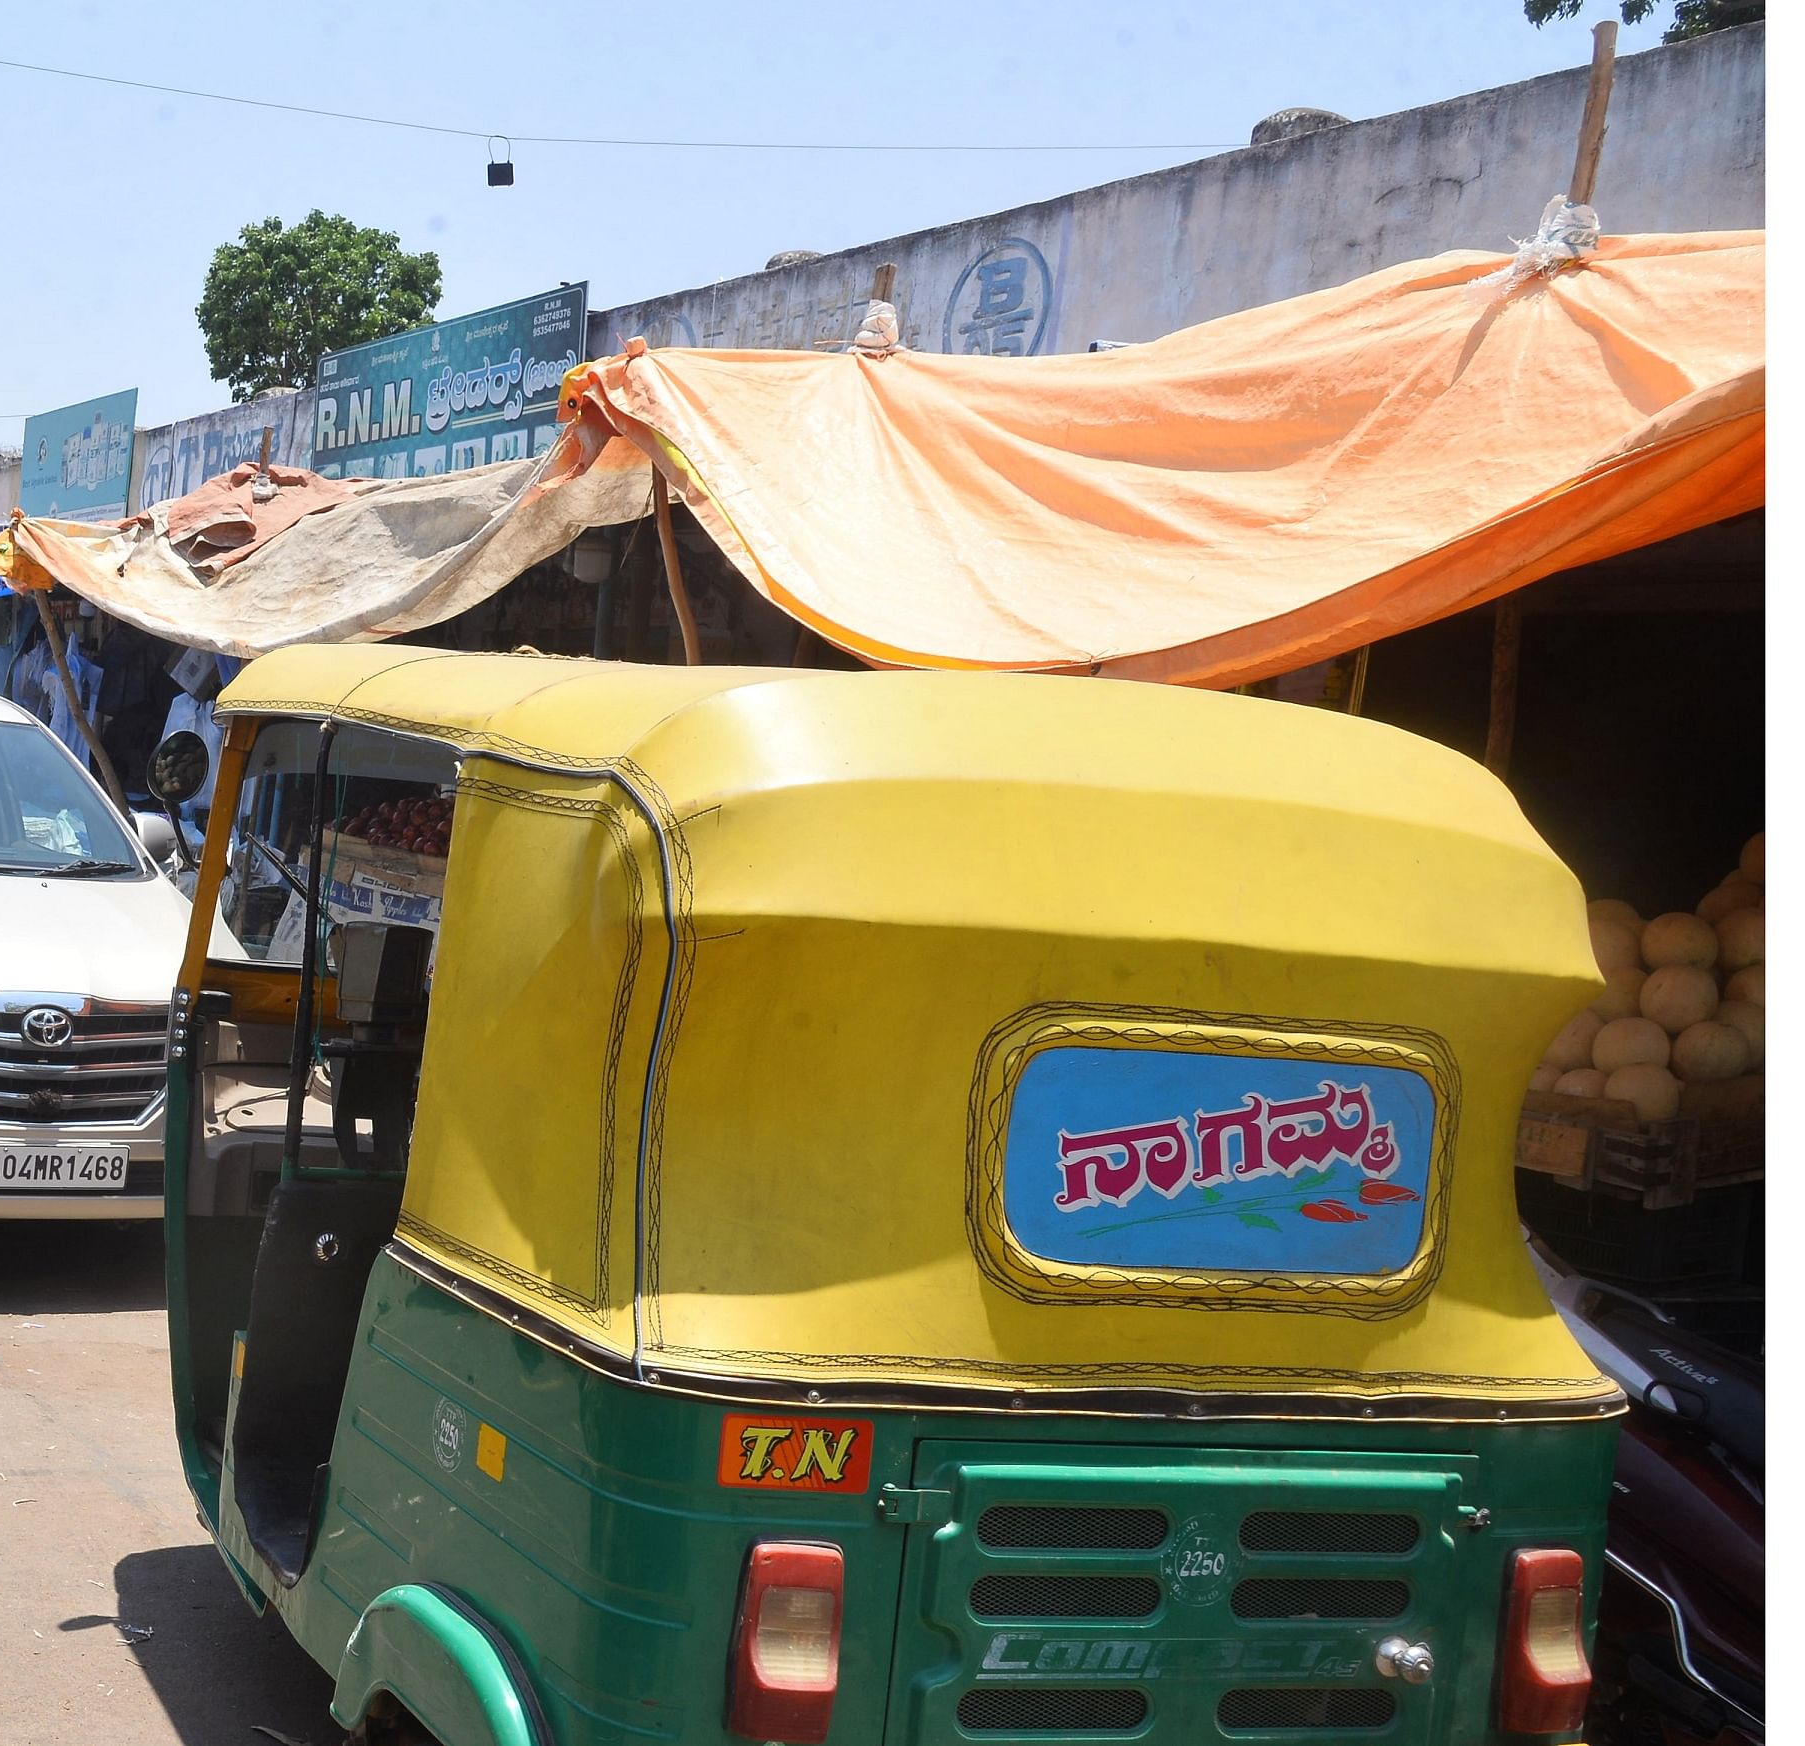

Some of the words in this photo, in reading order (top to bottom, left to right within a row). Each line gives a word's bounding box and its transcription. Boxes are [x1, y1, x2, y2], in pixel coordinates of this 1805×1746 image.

[315, 379, 421, 452] R.N.M.
[1054, 1080, 1401, 1212] ನಾಗಮ್ಮ
[740, 1426, 857, 1482] T.N
[1179, 1550, 1225, 1577] 2250
